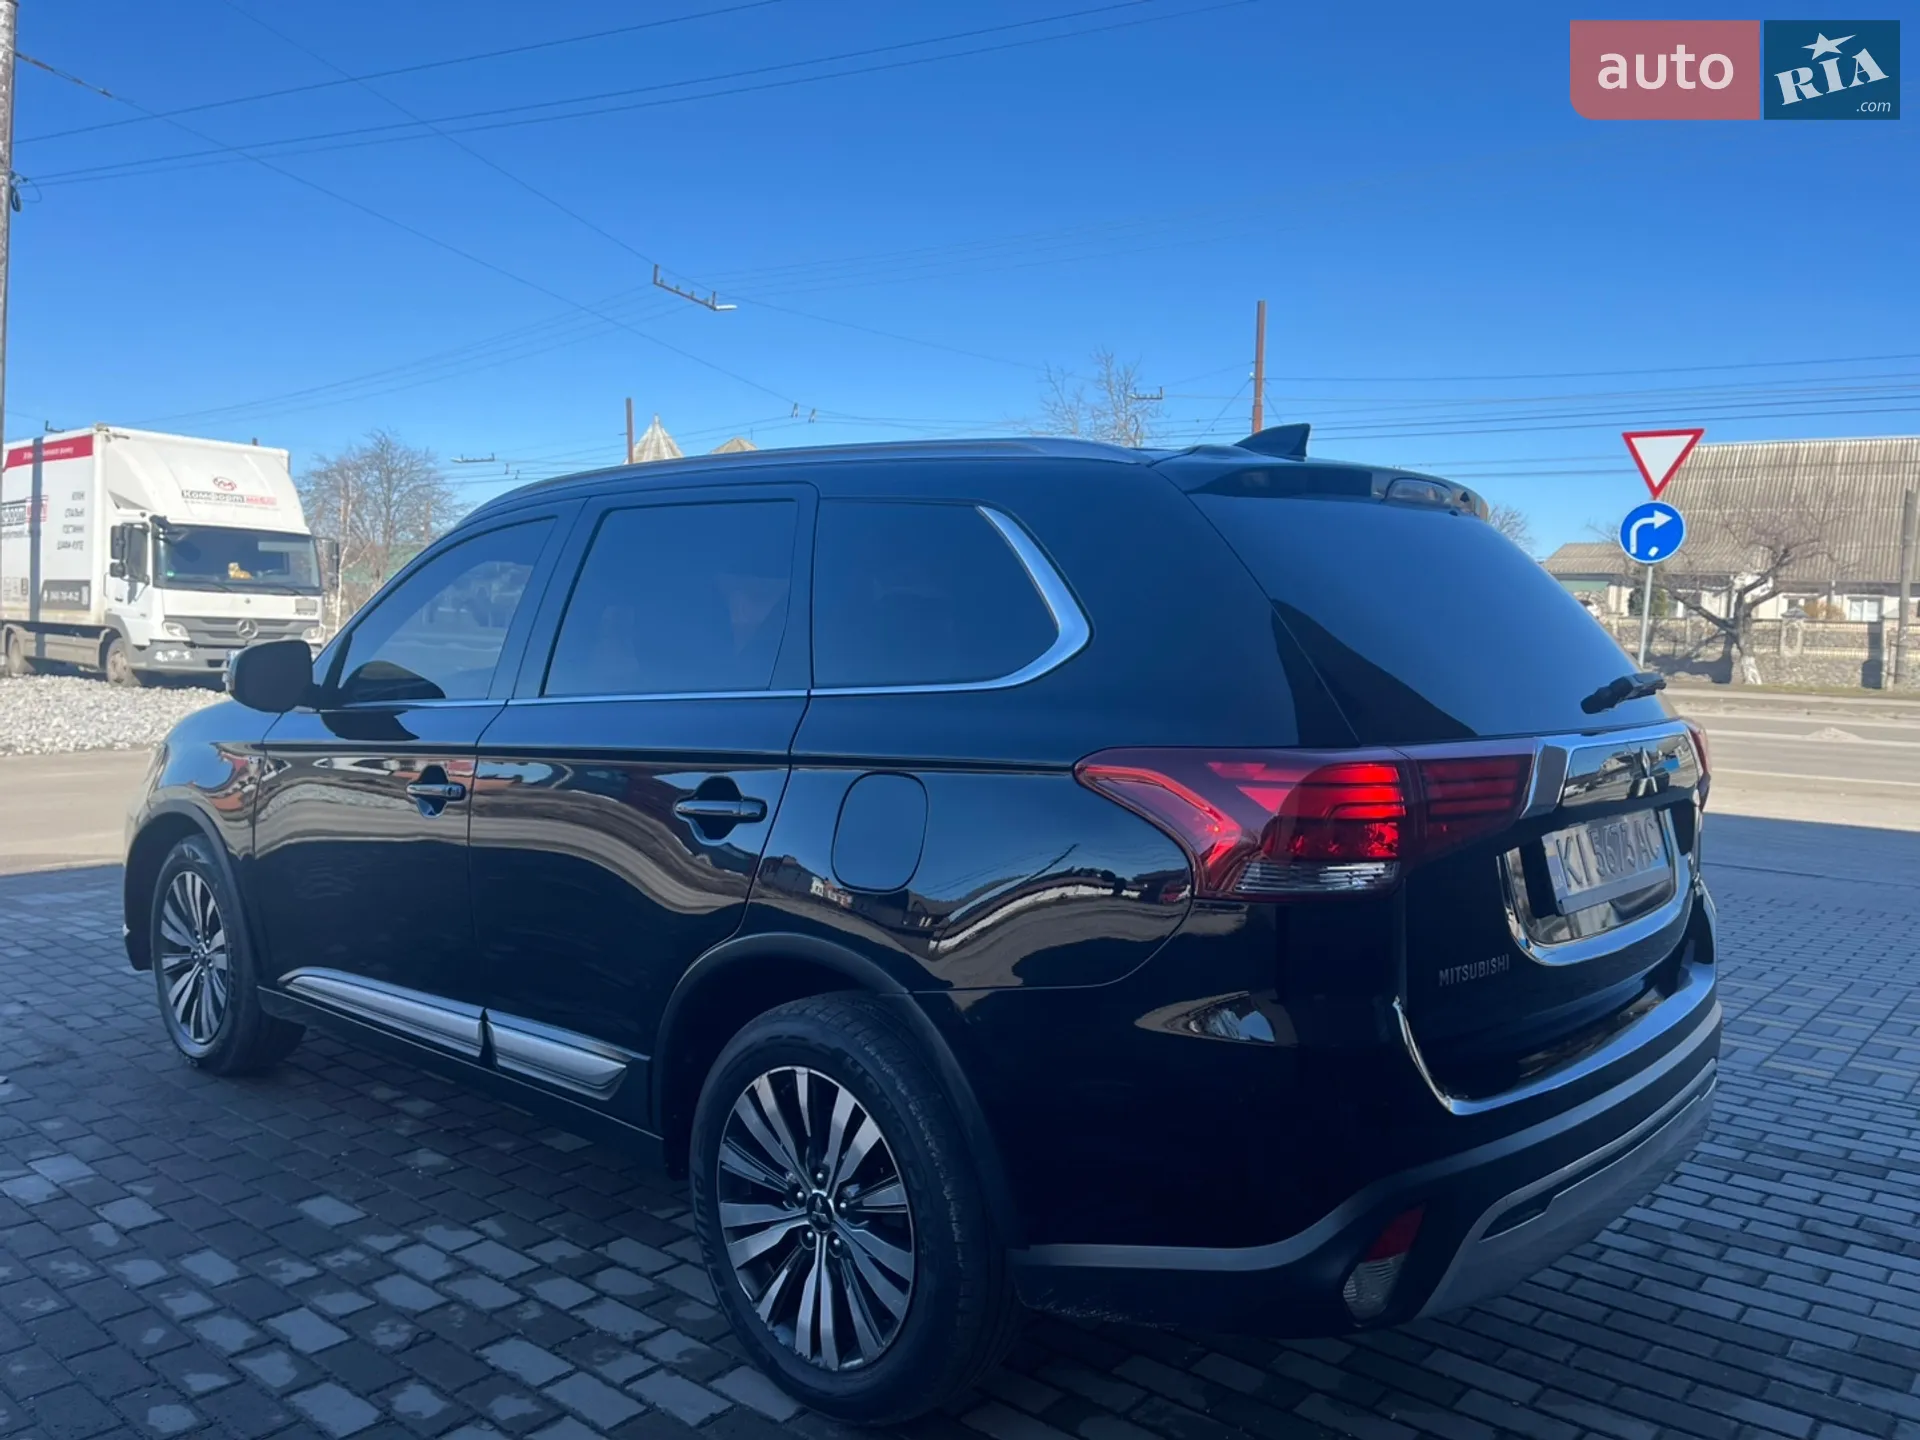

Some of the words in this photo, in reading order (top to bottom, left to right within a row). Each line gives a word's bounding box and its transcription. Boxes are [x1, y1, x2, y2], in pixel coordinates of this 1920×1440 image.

[1556, 834, 1592, 890] KI
[1633, 817, 1660, 868] AC
[1438, 953, 1510, 987] MITSUBISHI
